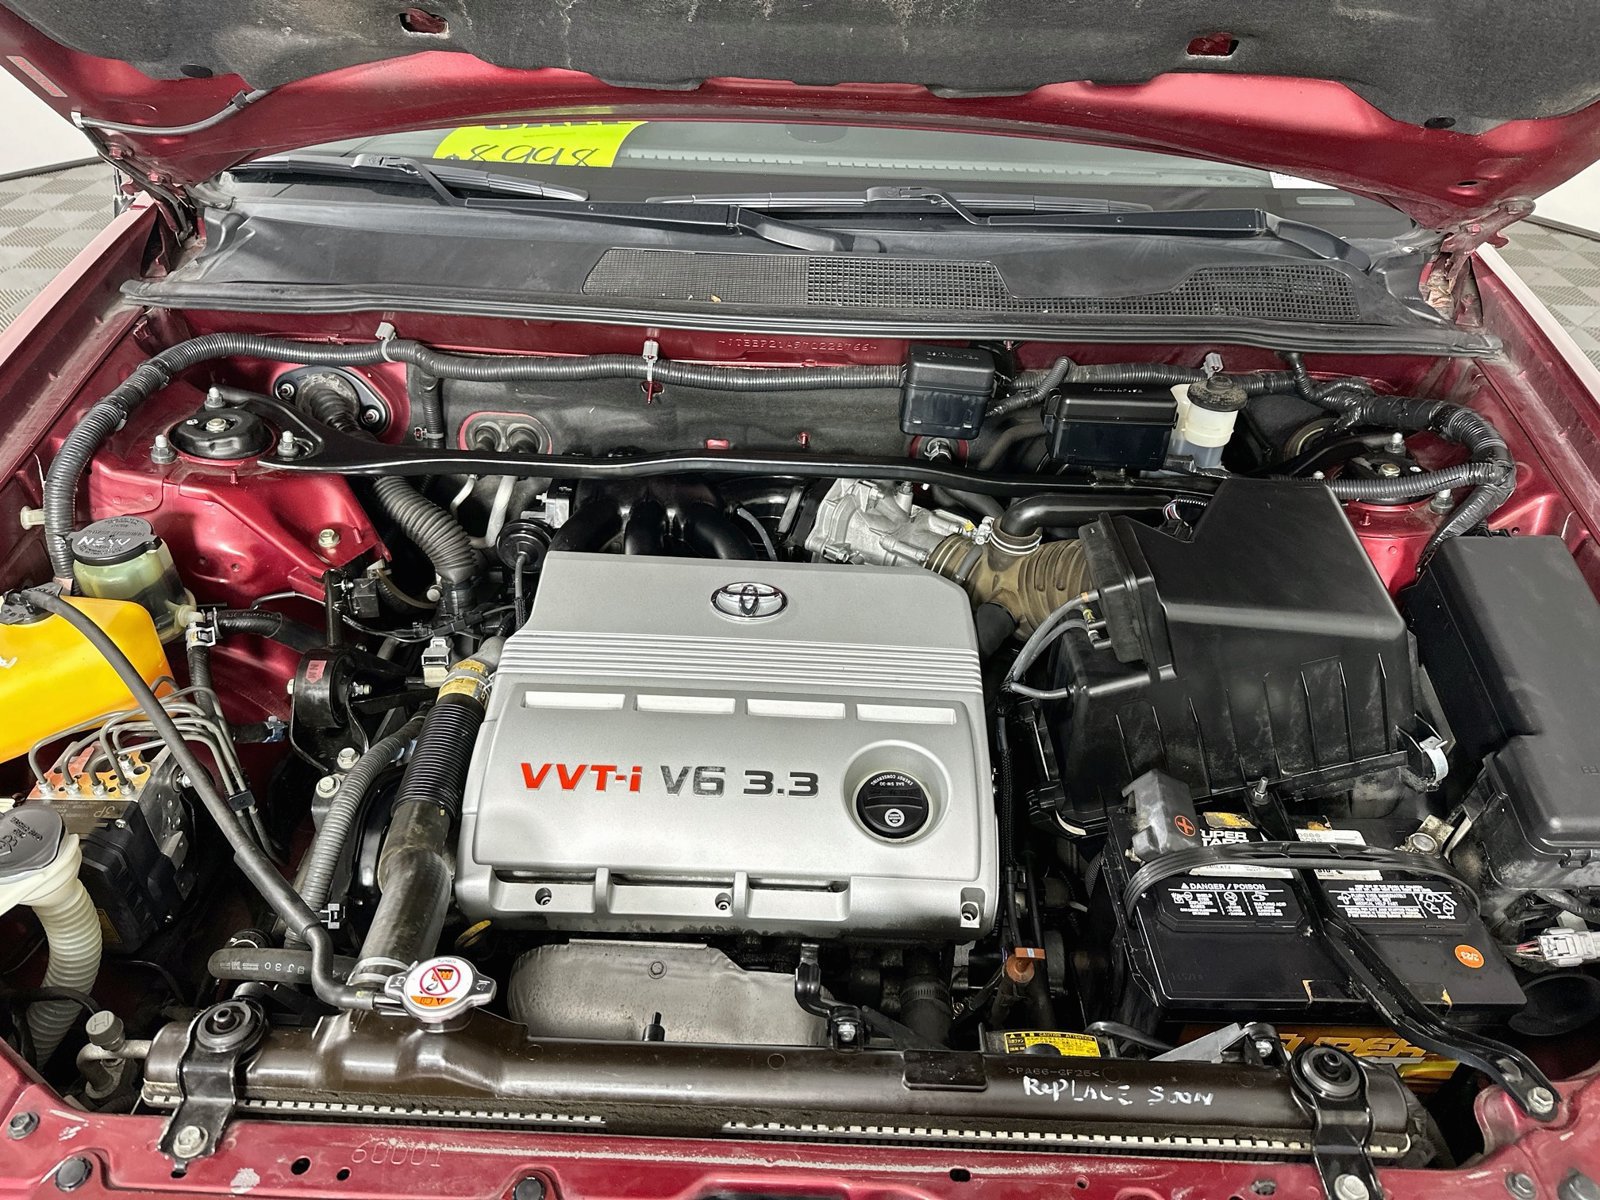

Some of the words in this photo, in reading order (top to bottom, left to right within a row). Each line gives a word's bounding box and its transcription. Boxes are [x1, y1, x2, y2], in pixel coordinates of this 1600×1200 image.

[521, 763, 642, 792] VVT-i
[660, 765, 726, 797] V6
[743, 770, 819, 797] 3.3
[1200, 829, 1248, 840] UPER
[1147, 1086, 1214, 1106] SOON
[352, 1140, 441, 1167] 60001
